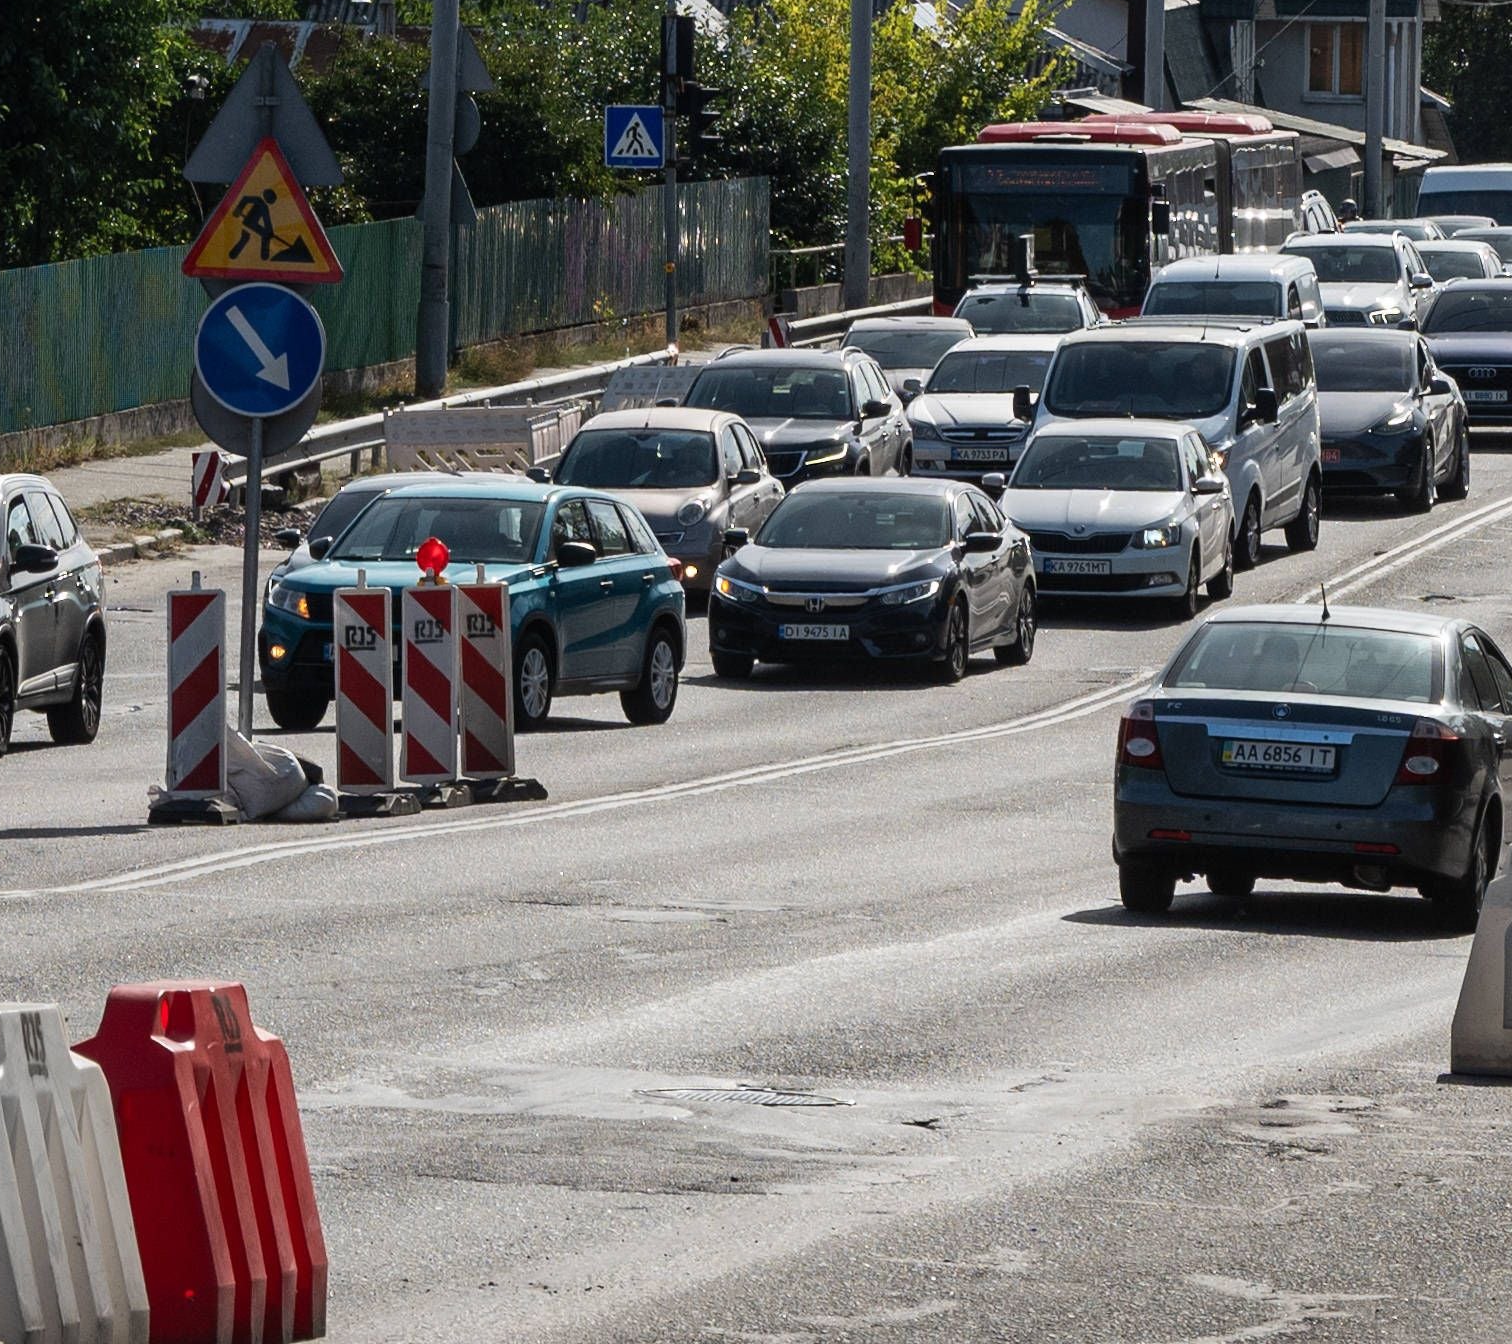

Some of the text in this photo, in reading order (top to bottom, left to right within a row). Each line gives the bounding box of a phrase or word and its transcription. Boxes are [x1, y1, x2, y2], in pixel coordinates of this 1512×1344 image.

[803, 626, 829, 638] 9475
[1234, 743, 1333, 765] AA 6856 IT
